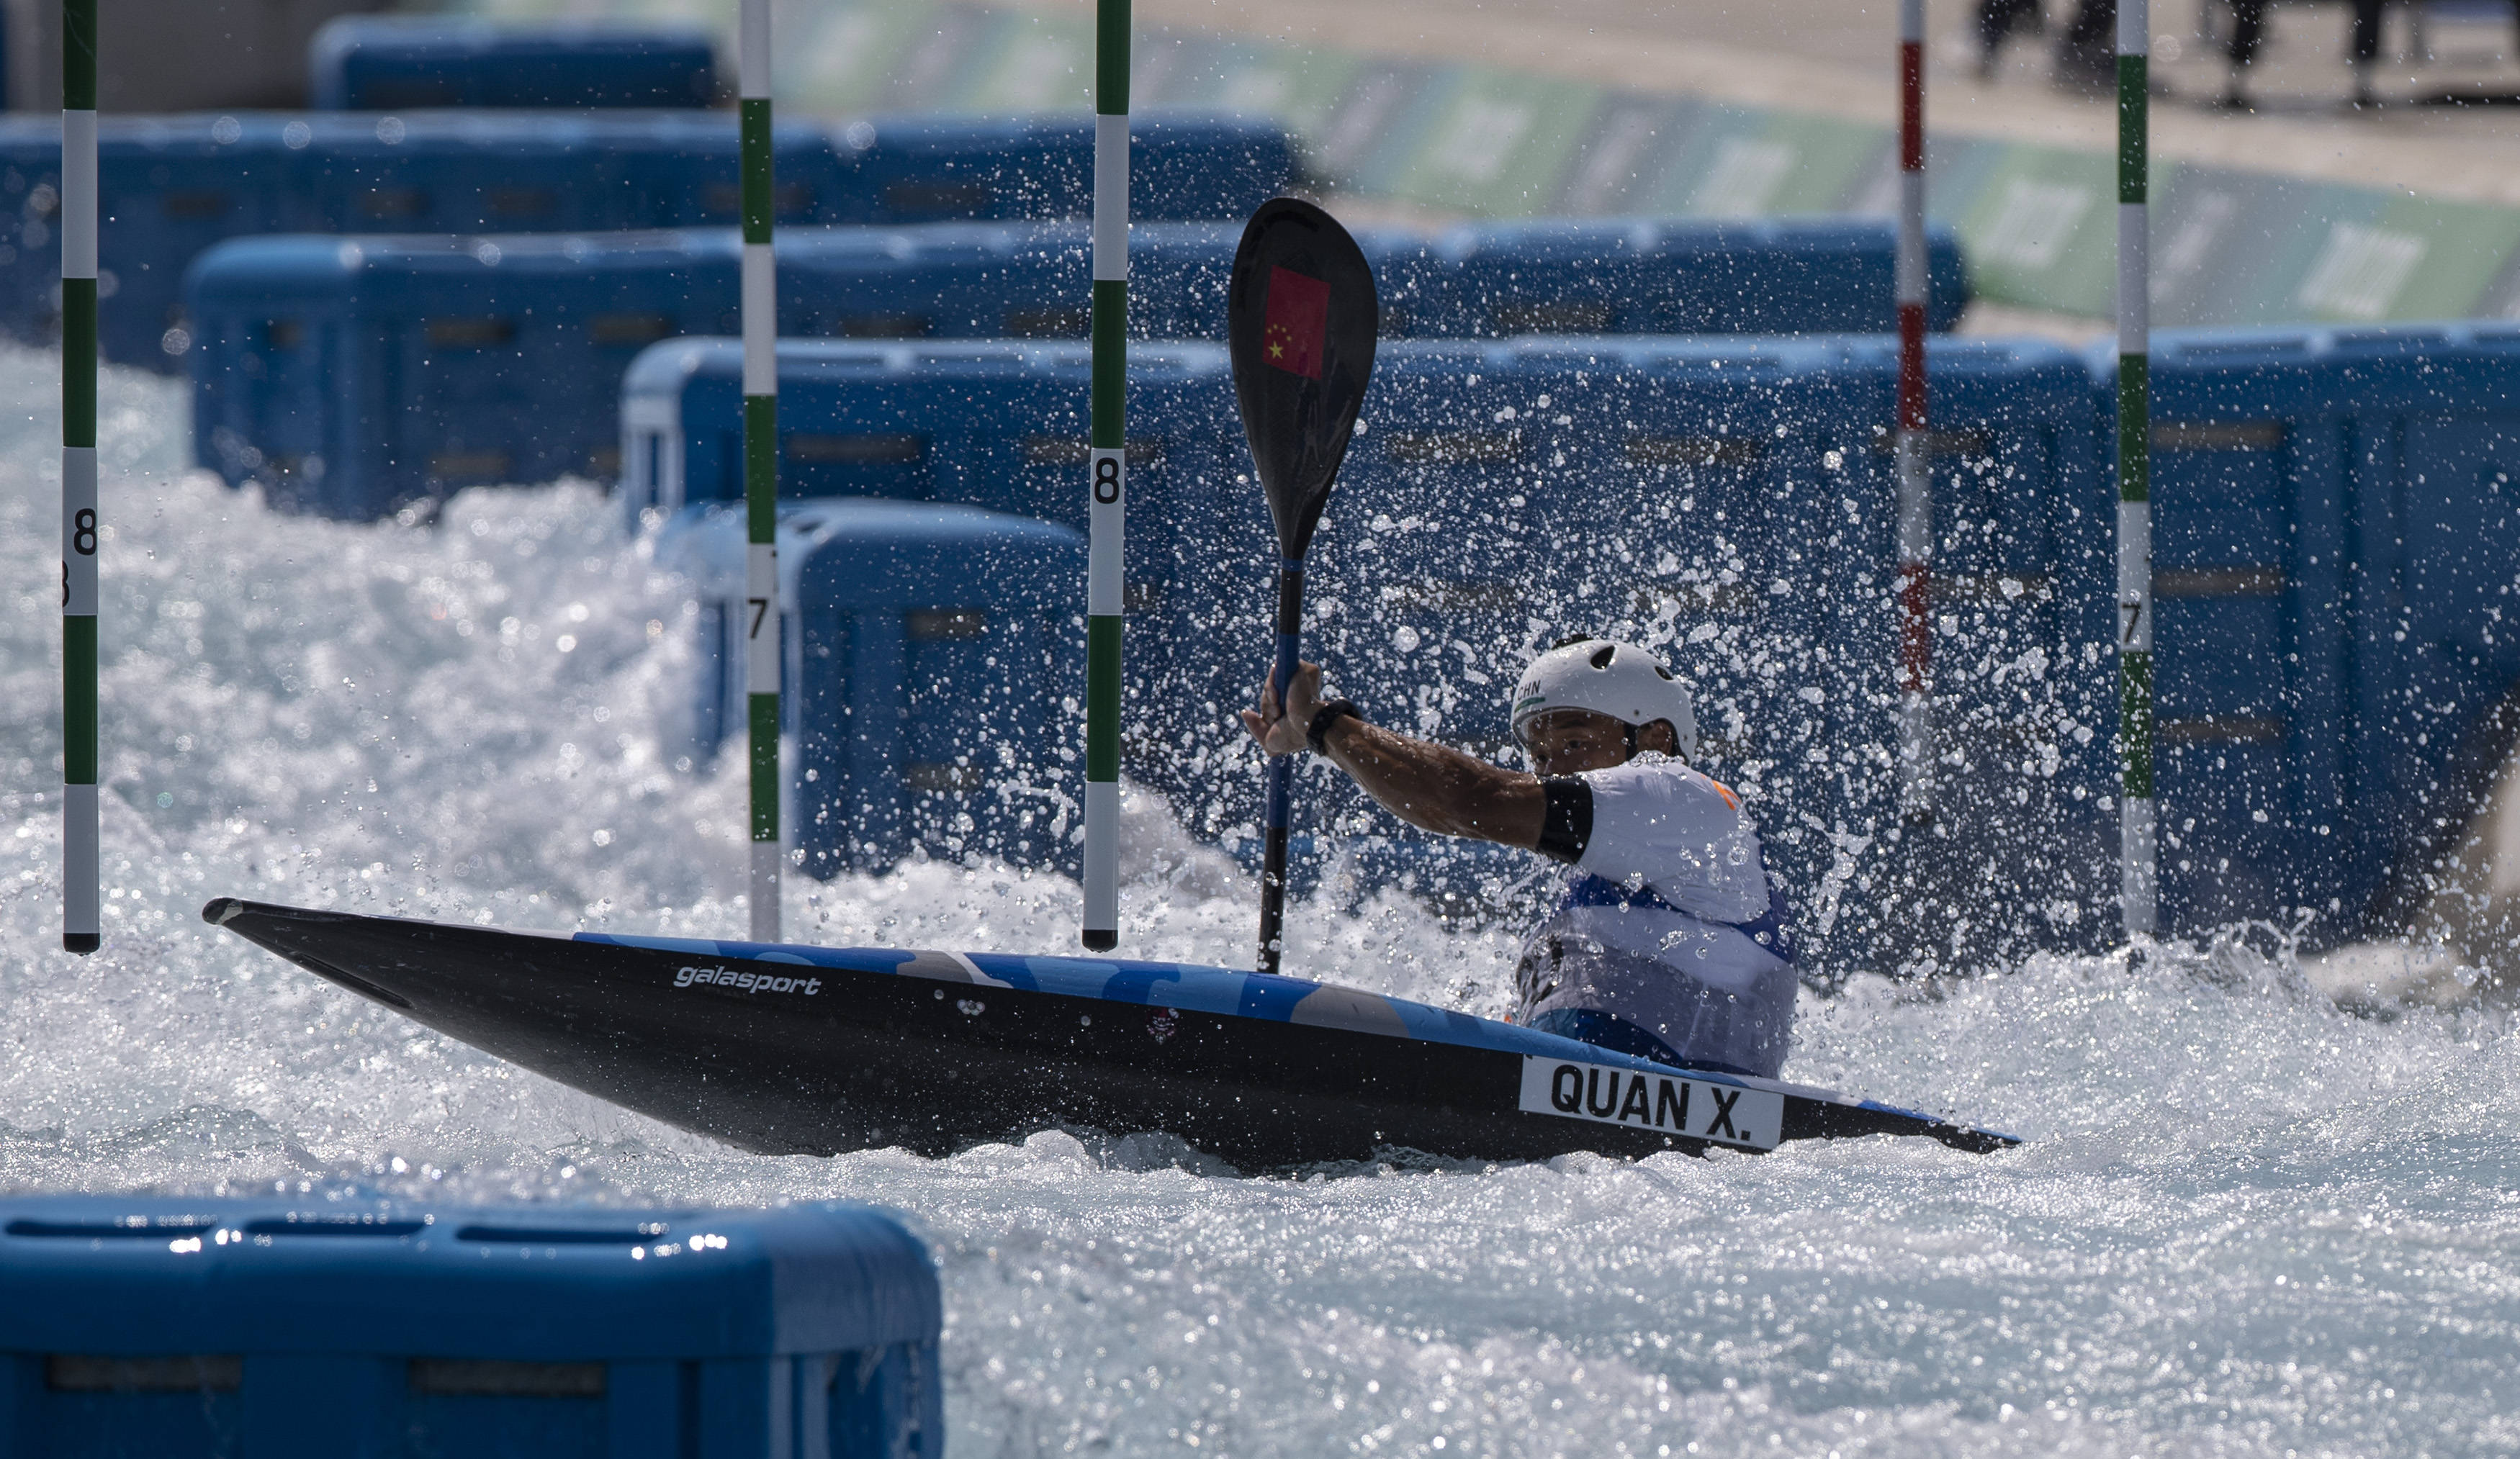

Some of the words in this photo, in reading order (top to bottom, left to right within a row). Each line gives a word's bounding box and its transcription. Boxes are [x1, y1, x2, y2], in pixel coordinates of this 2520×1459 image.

[1094, 457, 1120, 504] 8
[73, 508, 97, 556] 8
[748, 598, 769, 639] 7
[2121, 602, 2141, 643] 7
[1517, 679, 1541, 701] CHN
[673, 966, 822, 995] galasport
[1551, 1065, 1691, 1130] QUAN
[1706, 1087, 1750, 1141] X.
